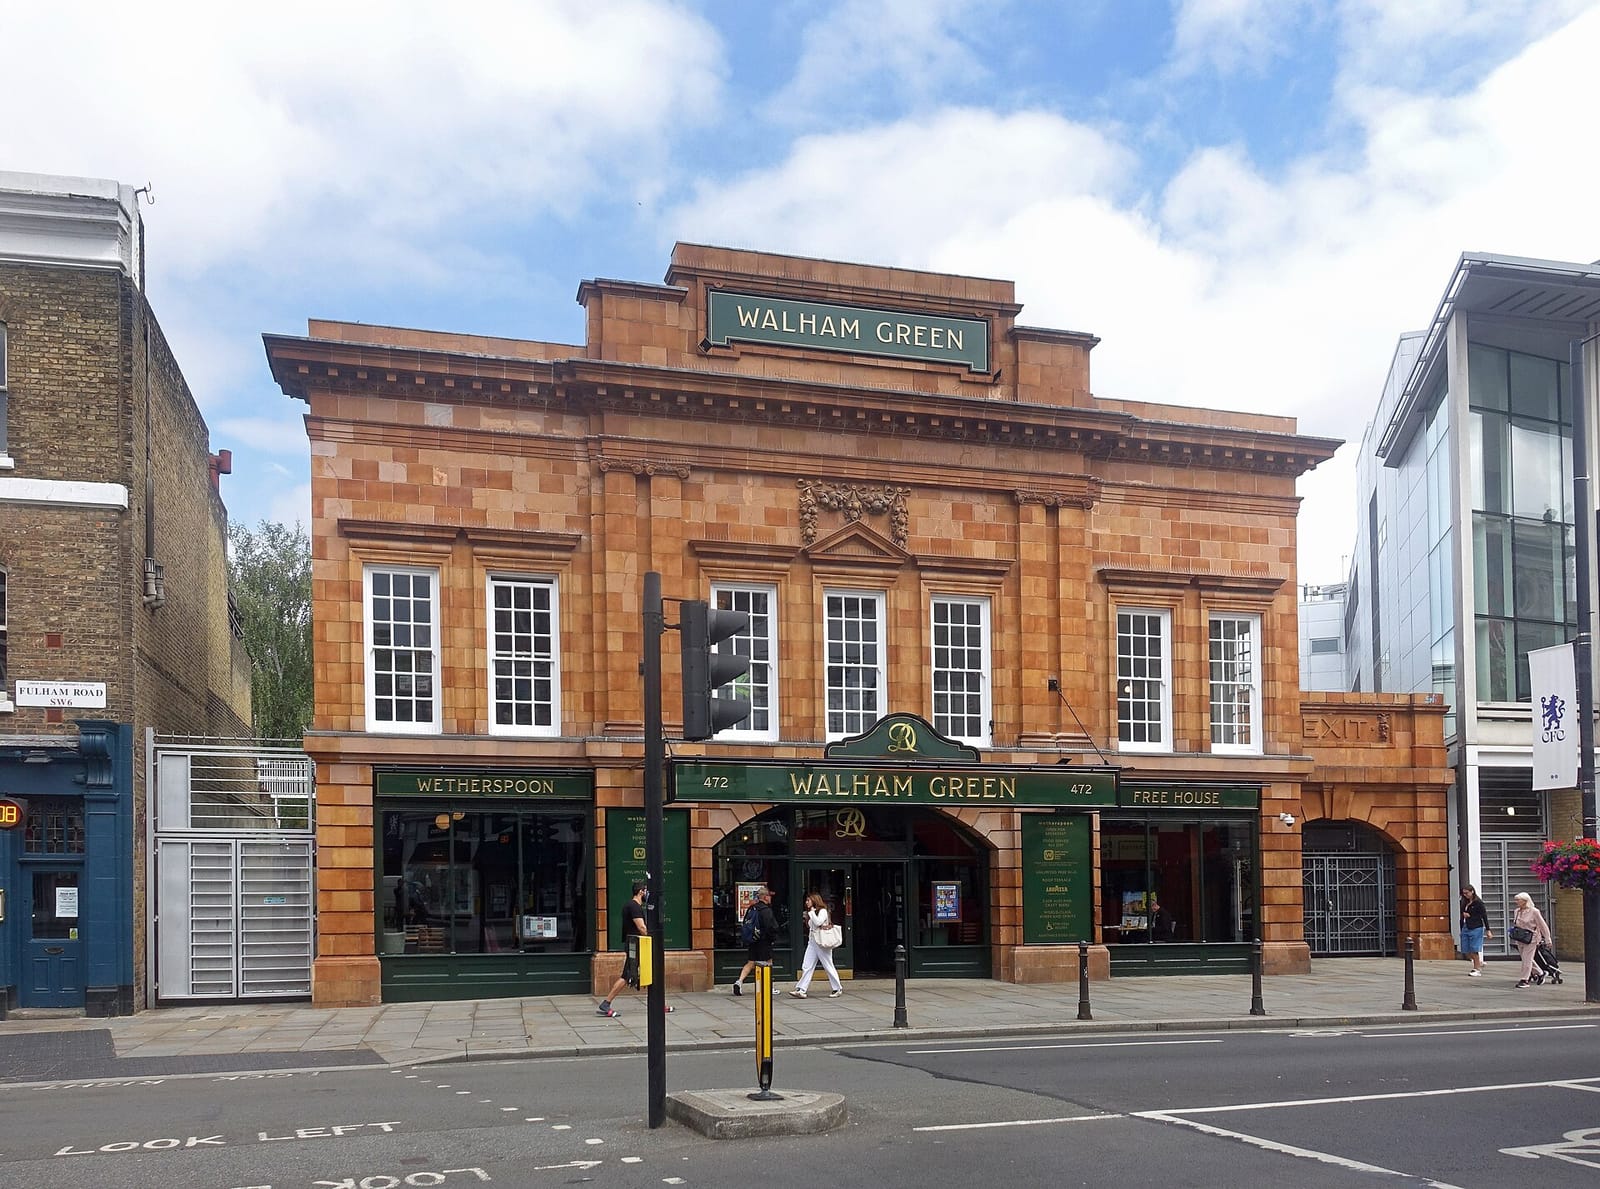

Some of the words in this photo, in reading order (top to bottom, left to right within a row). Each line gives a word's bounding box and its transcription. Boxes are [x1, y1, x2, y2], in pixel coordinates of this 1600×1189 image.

[737, 305, 860, 340] WALHAM
[876, 321, 964, 351] GREEN
[19, 687, 69, 696] FULHAM
[73, 688, 103, 697] ROAD
[50, 698, 73, 706] SW6
[1302, 718, 1368, 739] EXIT
[1541, 729, 1566, 743] CFC
[416, 778, 554, 794] WETHERSPOON
[703, 776, 729, 788] 472
[790, 773, 913, 797] WALHAM
[929, 776, 1016, 799] GREEN
[1070, 784, 1092, 795] 472
[1133, 791, 1169, 803] FREE
[1173, 791, 1220, 804] HOUSE
[53, 1134, 227, 1155] LOOK
[258, 1121, 402, 1141] LEFT
